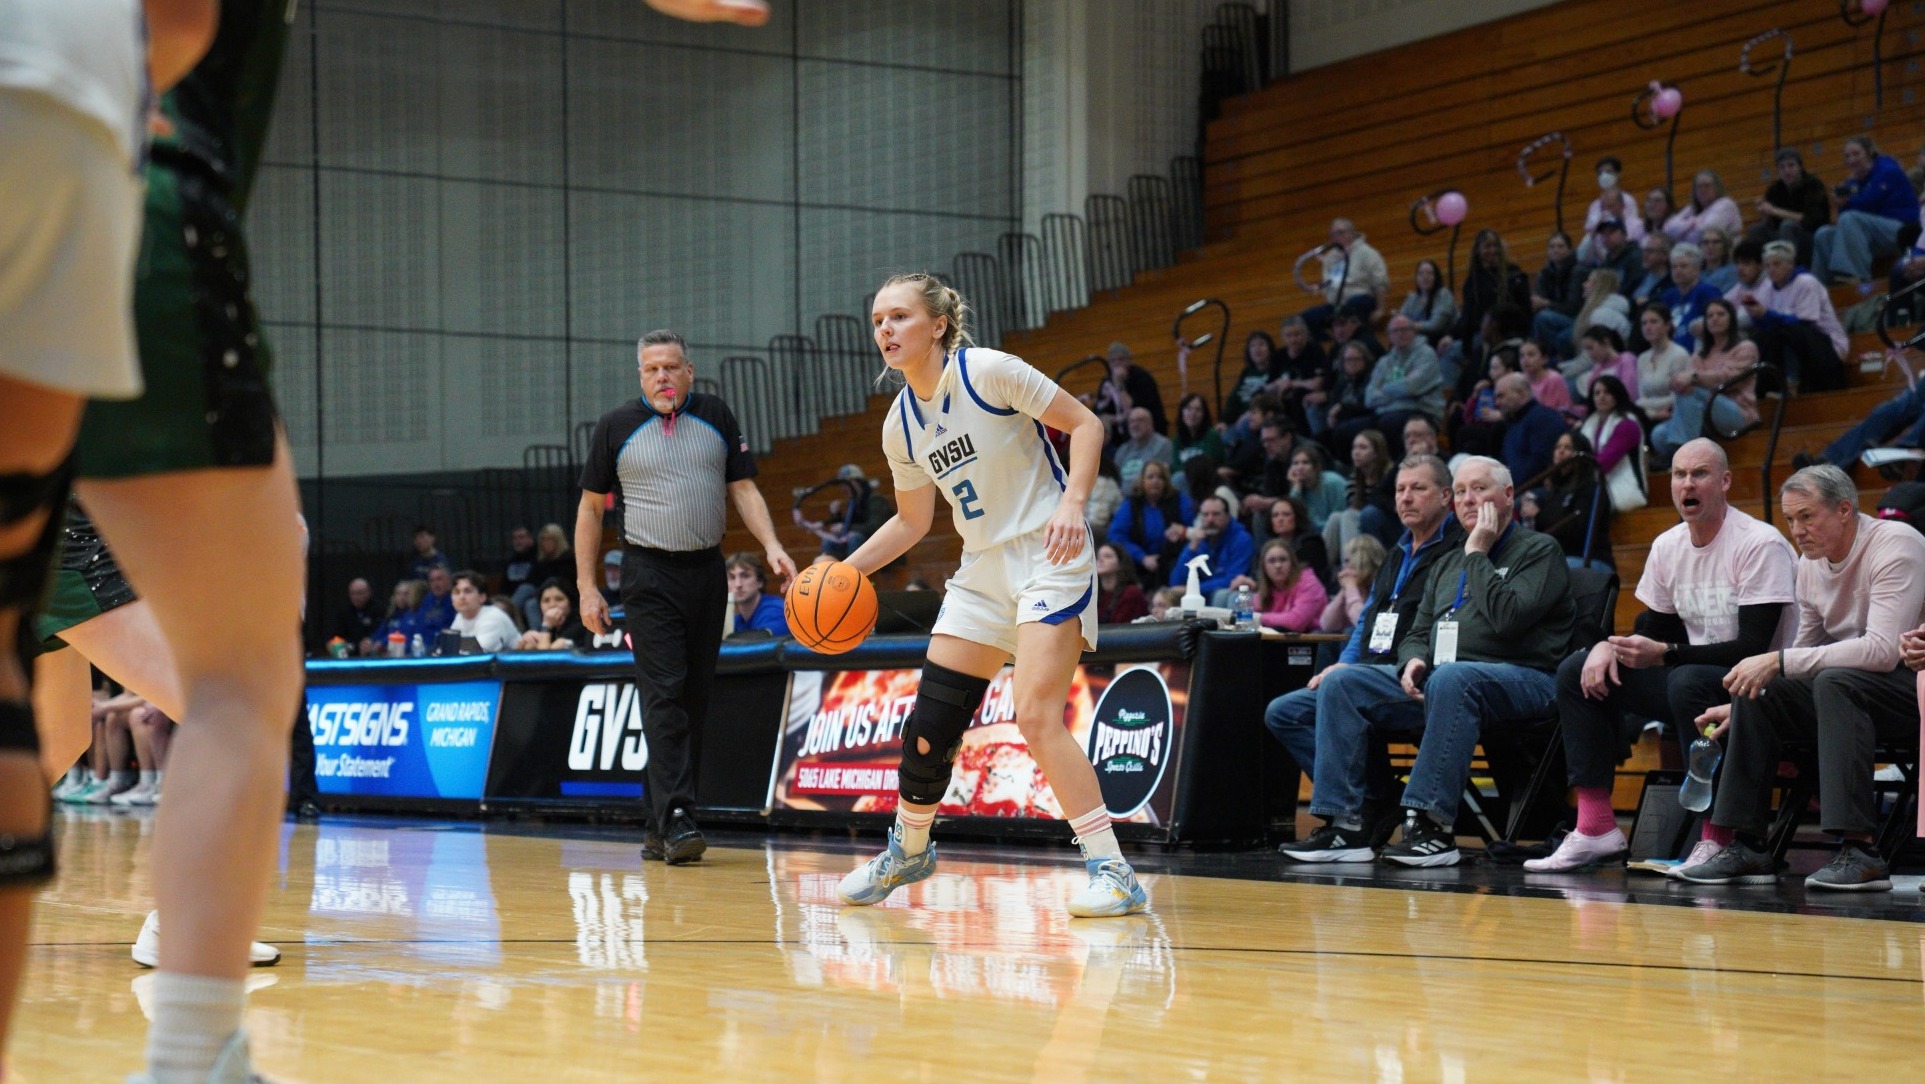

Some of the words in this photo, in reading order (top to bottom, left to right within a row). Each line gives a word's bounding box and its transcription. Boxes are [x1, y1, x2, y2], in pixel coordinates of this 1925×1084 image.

[928, 433, 975, 474] GVSU
[952, 479, 985, 520] 2
[306, 702, 414, 746] ASTSIGNS
[426, 702, 459, 722] GRAND
[568, 683, 649, 771] GVS
[797, 708, 847, 757] JOIN
[845, 702, 876, 750] US
[872, 693, 919, 744] AFT
[980, 676, 1015, 725] GA
[429, 727, 478, 748] MICHIGAN
[1092, 721, 1164, 766] PEPPINO'S
[315, 753, 339, 776] Your
[818, 768, 842, 790] LAKE
[841, 769, 884, 791] MICHIGAN
